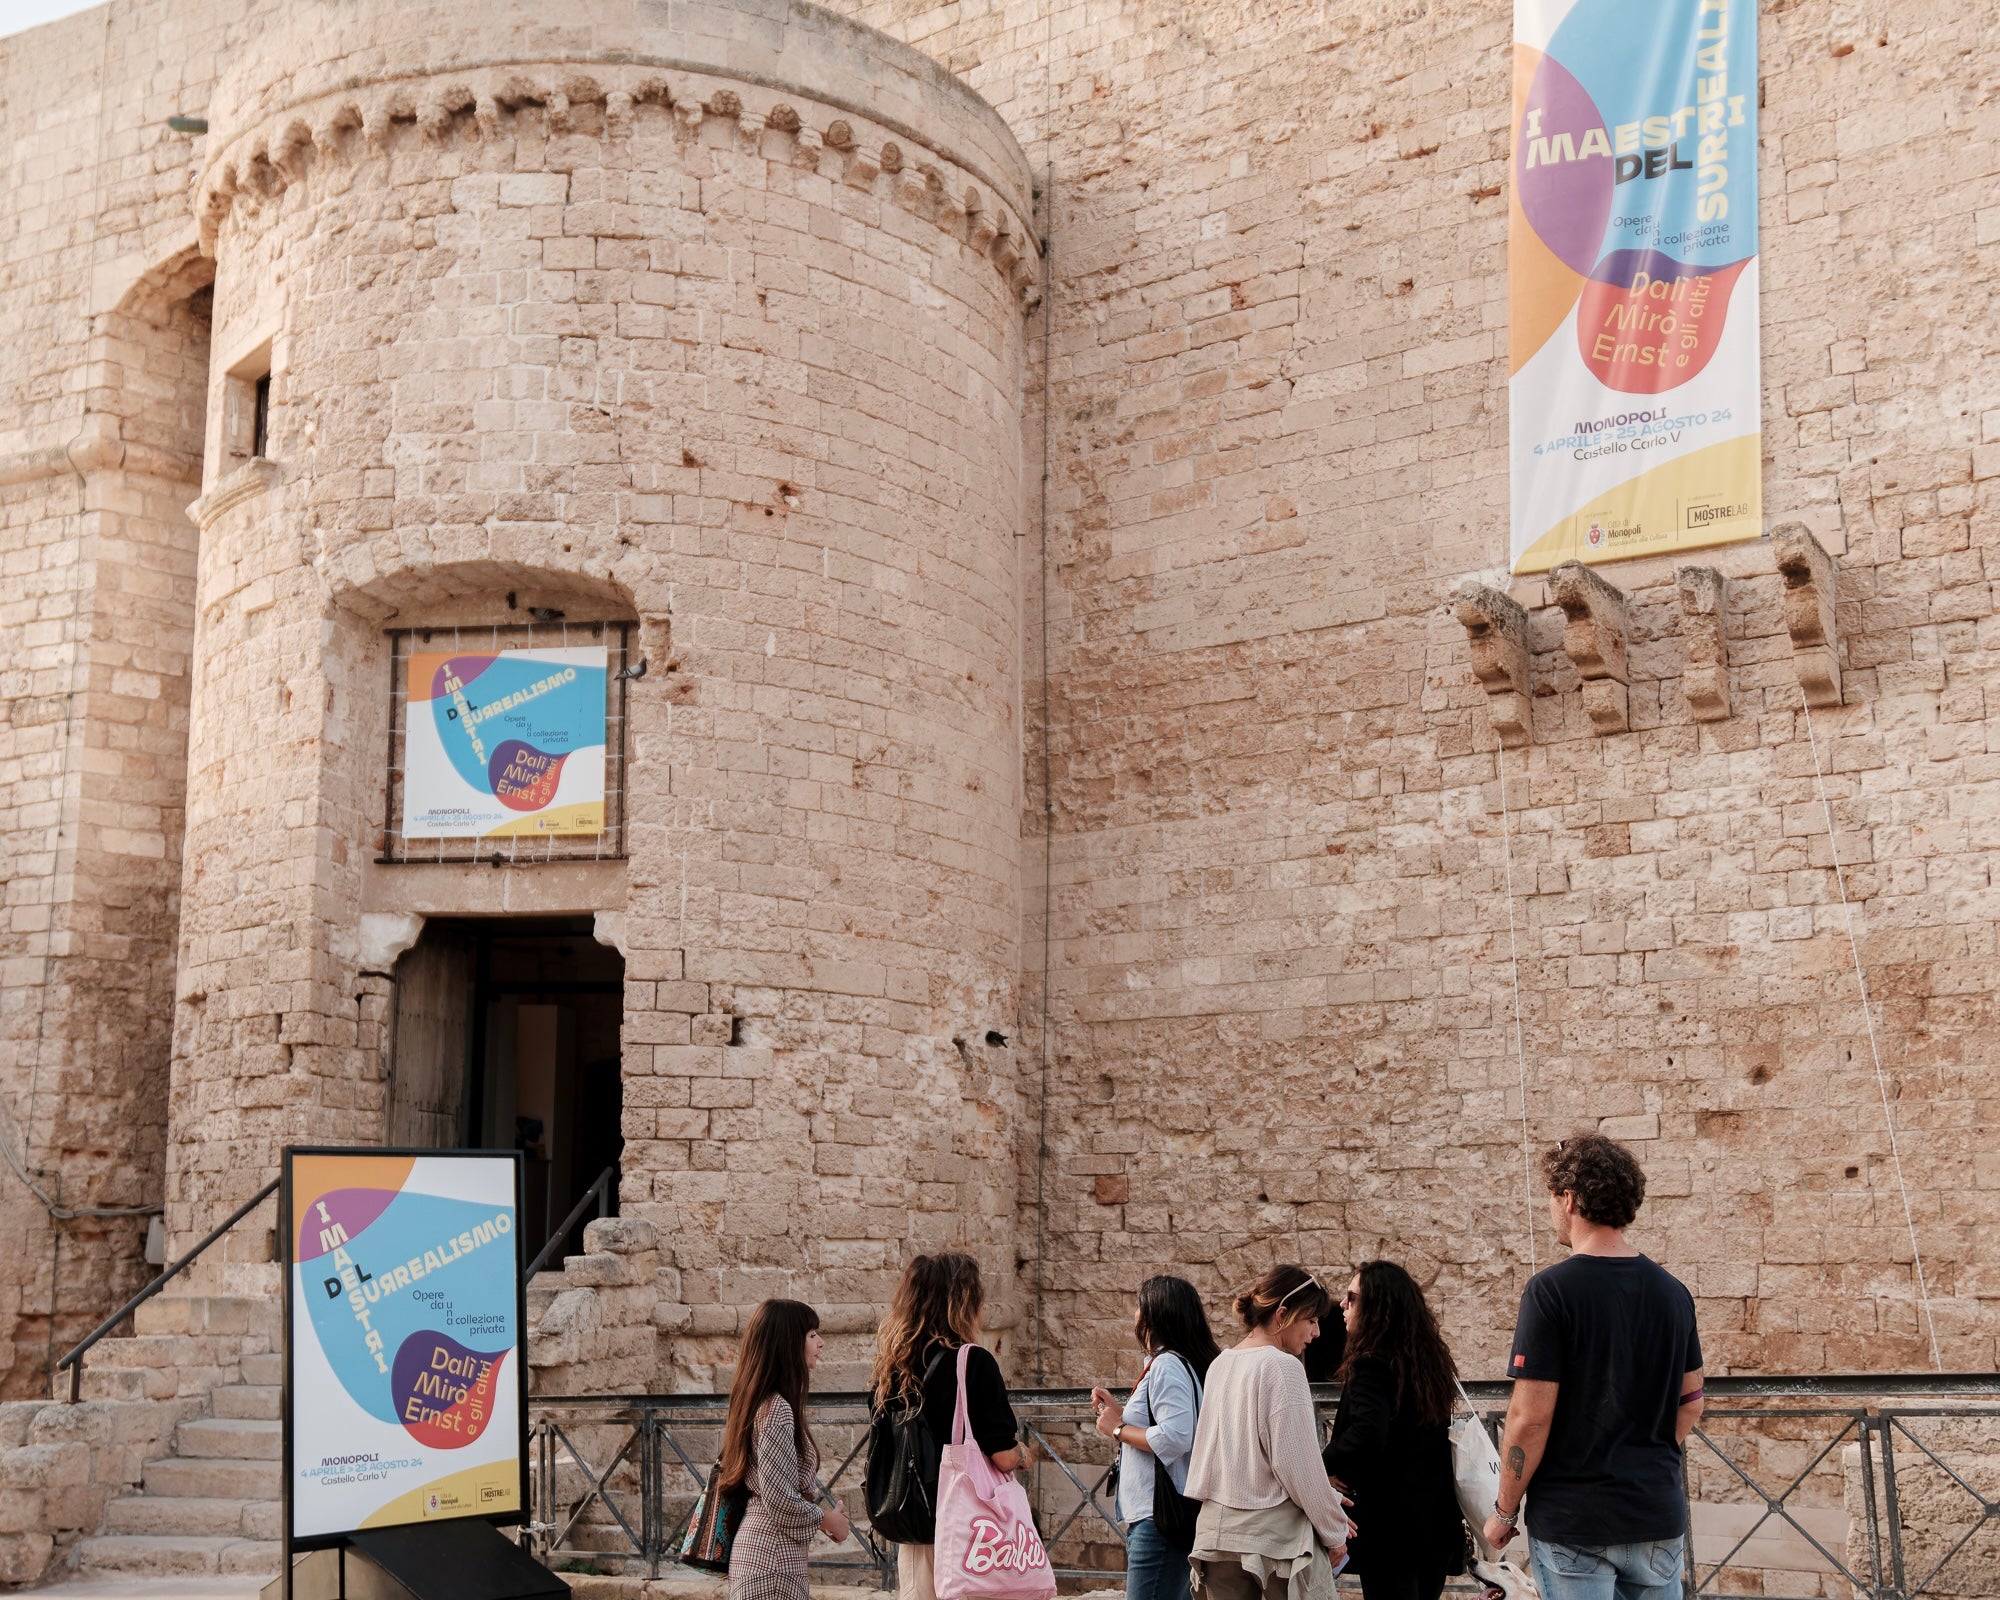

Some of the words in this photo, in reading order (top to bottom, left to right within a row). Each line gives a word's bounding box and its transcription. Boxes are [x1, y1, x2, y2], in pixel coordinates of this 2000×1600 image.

[1526, 107, 1542, 138] I
[1526, 95, 1746, 170] MAESTRI
[1615, 142, 1693, 186] DEL
[1613, 214, 1653, 229] Opere
[1635, 224, 1652, 236] da
[1664, 223, 1729, 246] collezione
[1683, 234, 1731, 256] privata
[1690, 275, 1713, 318] altri
[1604, 303, 1677, 336] Mirò
[1680, 324, 1699, 350] gli
[1592, 333, 1670, 368] Ernst
[1676, 354, 1689, 368] e
[1533, 444, 1544, 456] 4
[1545, 431, 1602, 454] APRILE
[1616, 426, 1638, 440] 25
[1640, 413, 1708, 437] AGOSTO
[1711, 408, 1733, 422] 24
[1574, 407, 1668, 435] MONOPOLI
[1573, 441, 1628, 461] Castello
[1631, 435, 1667, 451] Carlo
[1670, 431, 1682, 443] V
[1608, 524, 1641, 539] Monopoli
[443, 664, 452, 678] I
[446, 700, 478, 721] DEL
[504, 714, 526, 724] Opere
[516, 720, 526, 728] da
[533, 729, 568, 738] collezione
[542, 736, 569, 744] privata
[546, 757, 558, 780] altri
[496, 779, 536, 802] Ernst
[540, 780, 551, 797] gli
[538, 796, 546, 805] e
[316, 1201, 332, 1224] I
[323, 1264, 372, 1300] DEL
[412, 1290, 444, 1302] Opere
[430, 1300, 444, 1310] da
[455, 1313, 505, 1326] collezione
[470, 1324, 505, 1336] privata
[413, 1371, 468, 1405] Mirò
[476, 1360, 493, 1395] altri
[404, 1396, 463, 1432] Ernst
[470, 1398, 483, 1422] gli
[467, 1425, 476, 1436] e
[301, 1470, 307, 1478] 4
[309, 1466, 345, 1478] APRILE
[355, 1464, 367, 1473] 25
[369, 1459, 409, 1471] AGOSTO
[411, 1457, 423, 1467] 24
[321, 1453, 379, 1467] MONOPOLI
[321, 1474, 355, 1485] Castello
[357, 1472, 379, 1482] Carlo
[380, 1471, 387, 1479] V
[963, 1517, 1046, 1575] Barbie
